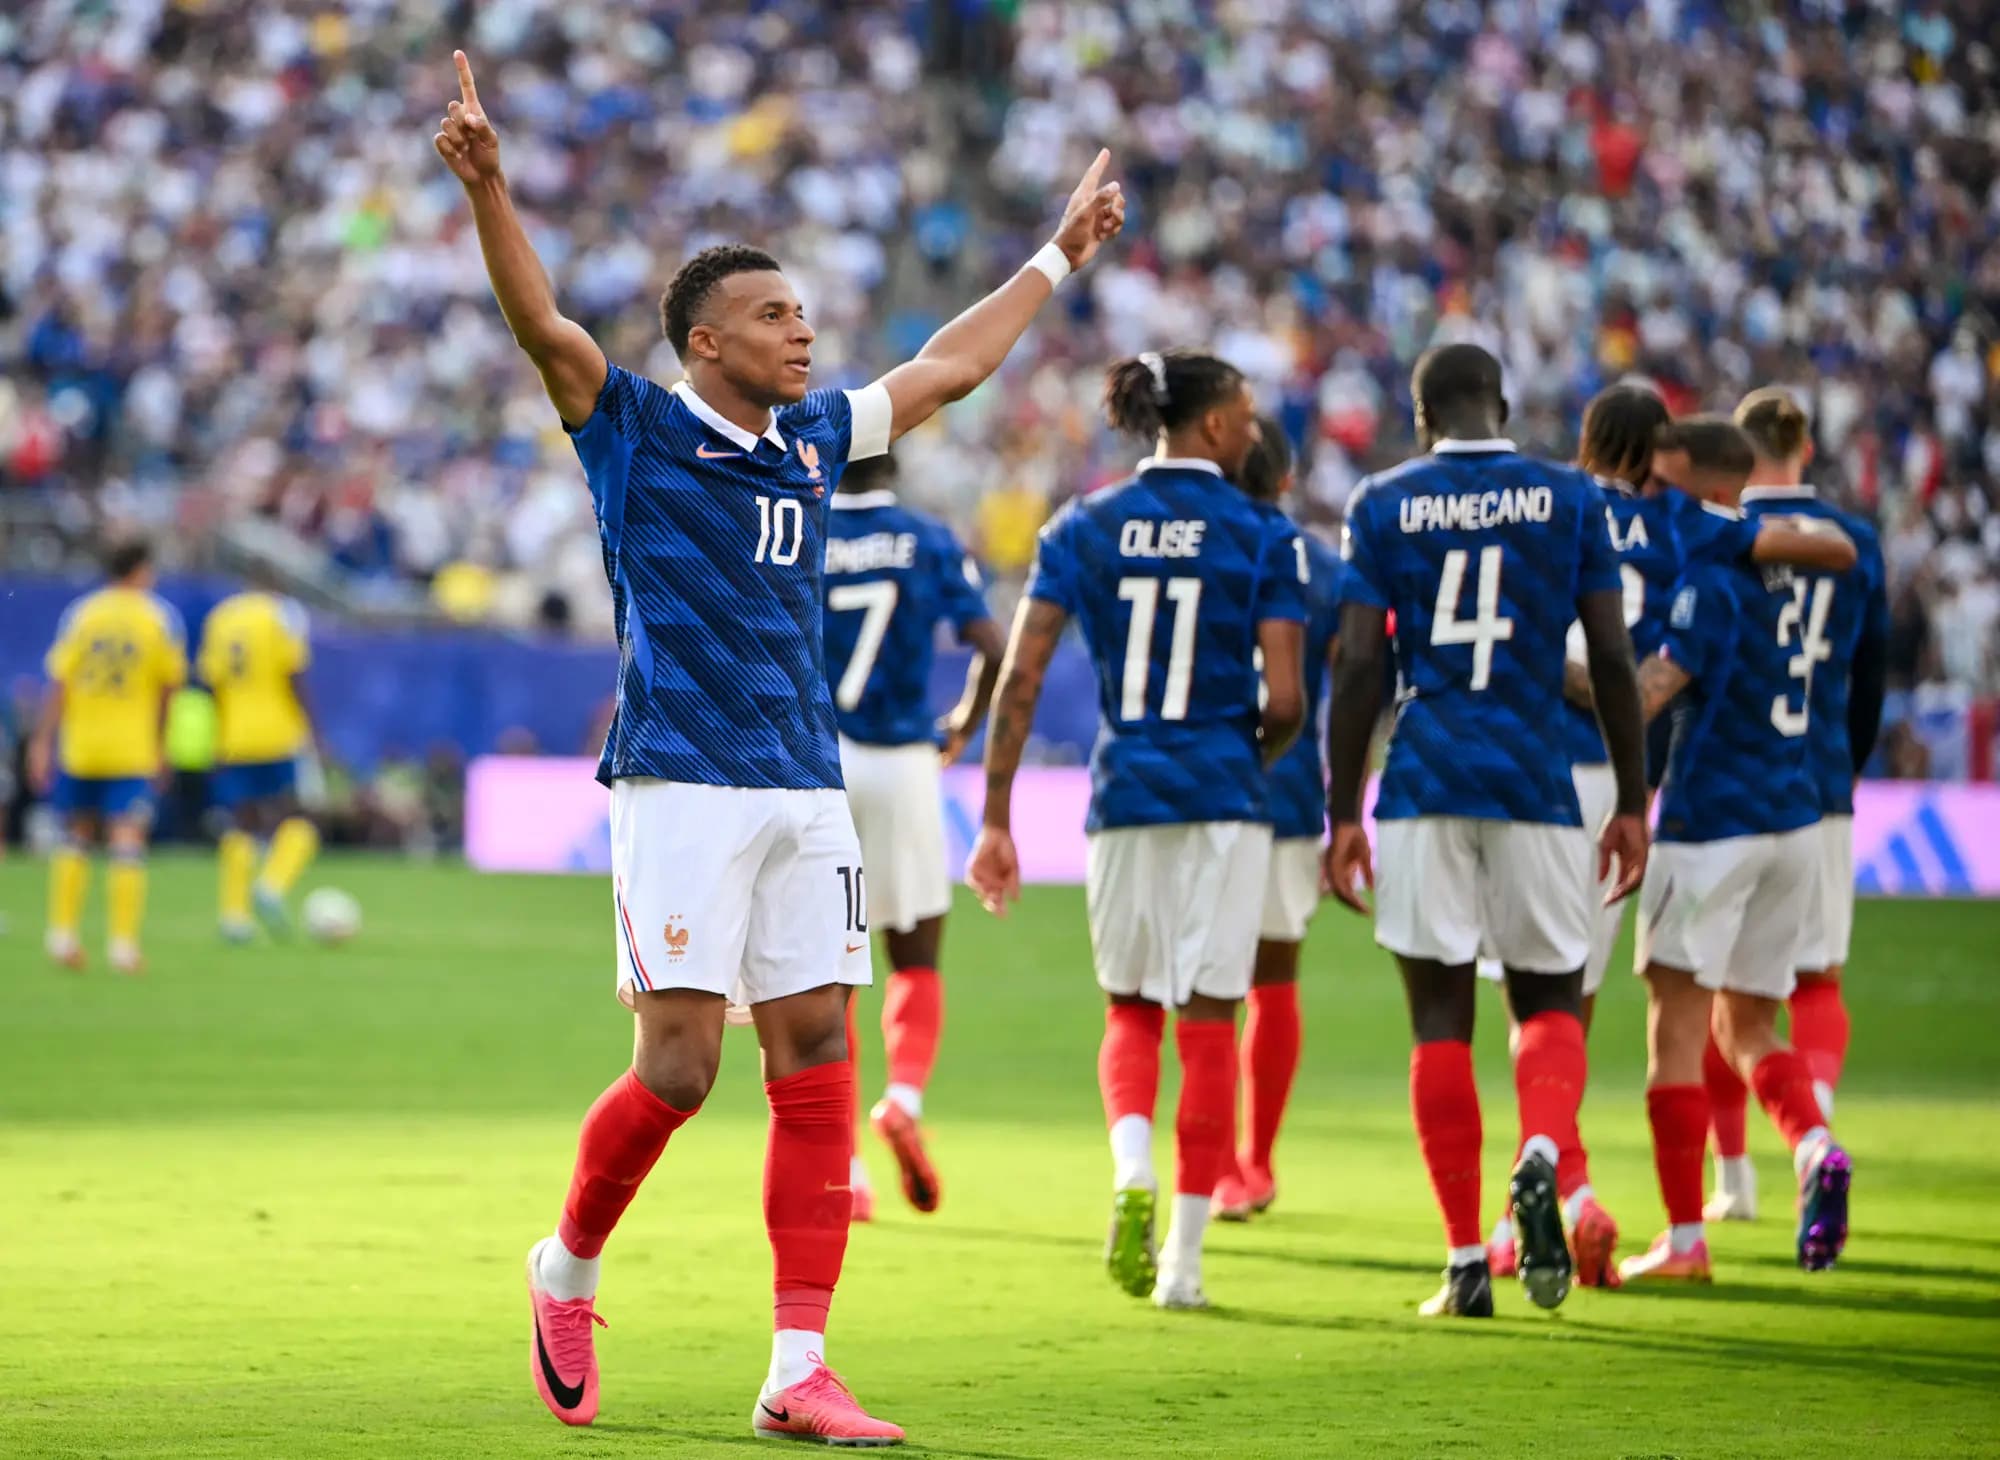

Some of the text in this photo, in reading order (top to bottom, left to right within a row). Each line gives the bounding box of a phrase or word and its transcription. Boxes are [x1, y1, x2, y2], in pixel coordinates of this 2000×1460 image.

[755, 495, 803, 567] 10
[1119, 520, 1206, 558] OLISE
[1400, 486, 1552, 533] UPAMECANO
[828, 580, 898, 712] 7
[1118, 577, 1202, 722] 11
[1430, 545, 1514, 691] 4
[837, 866, 867, 933] 10
